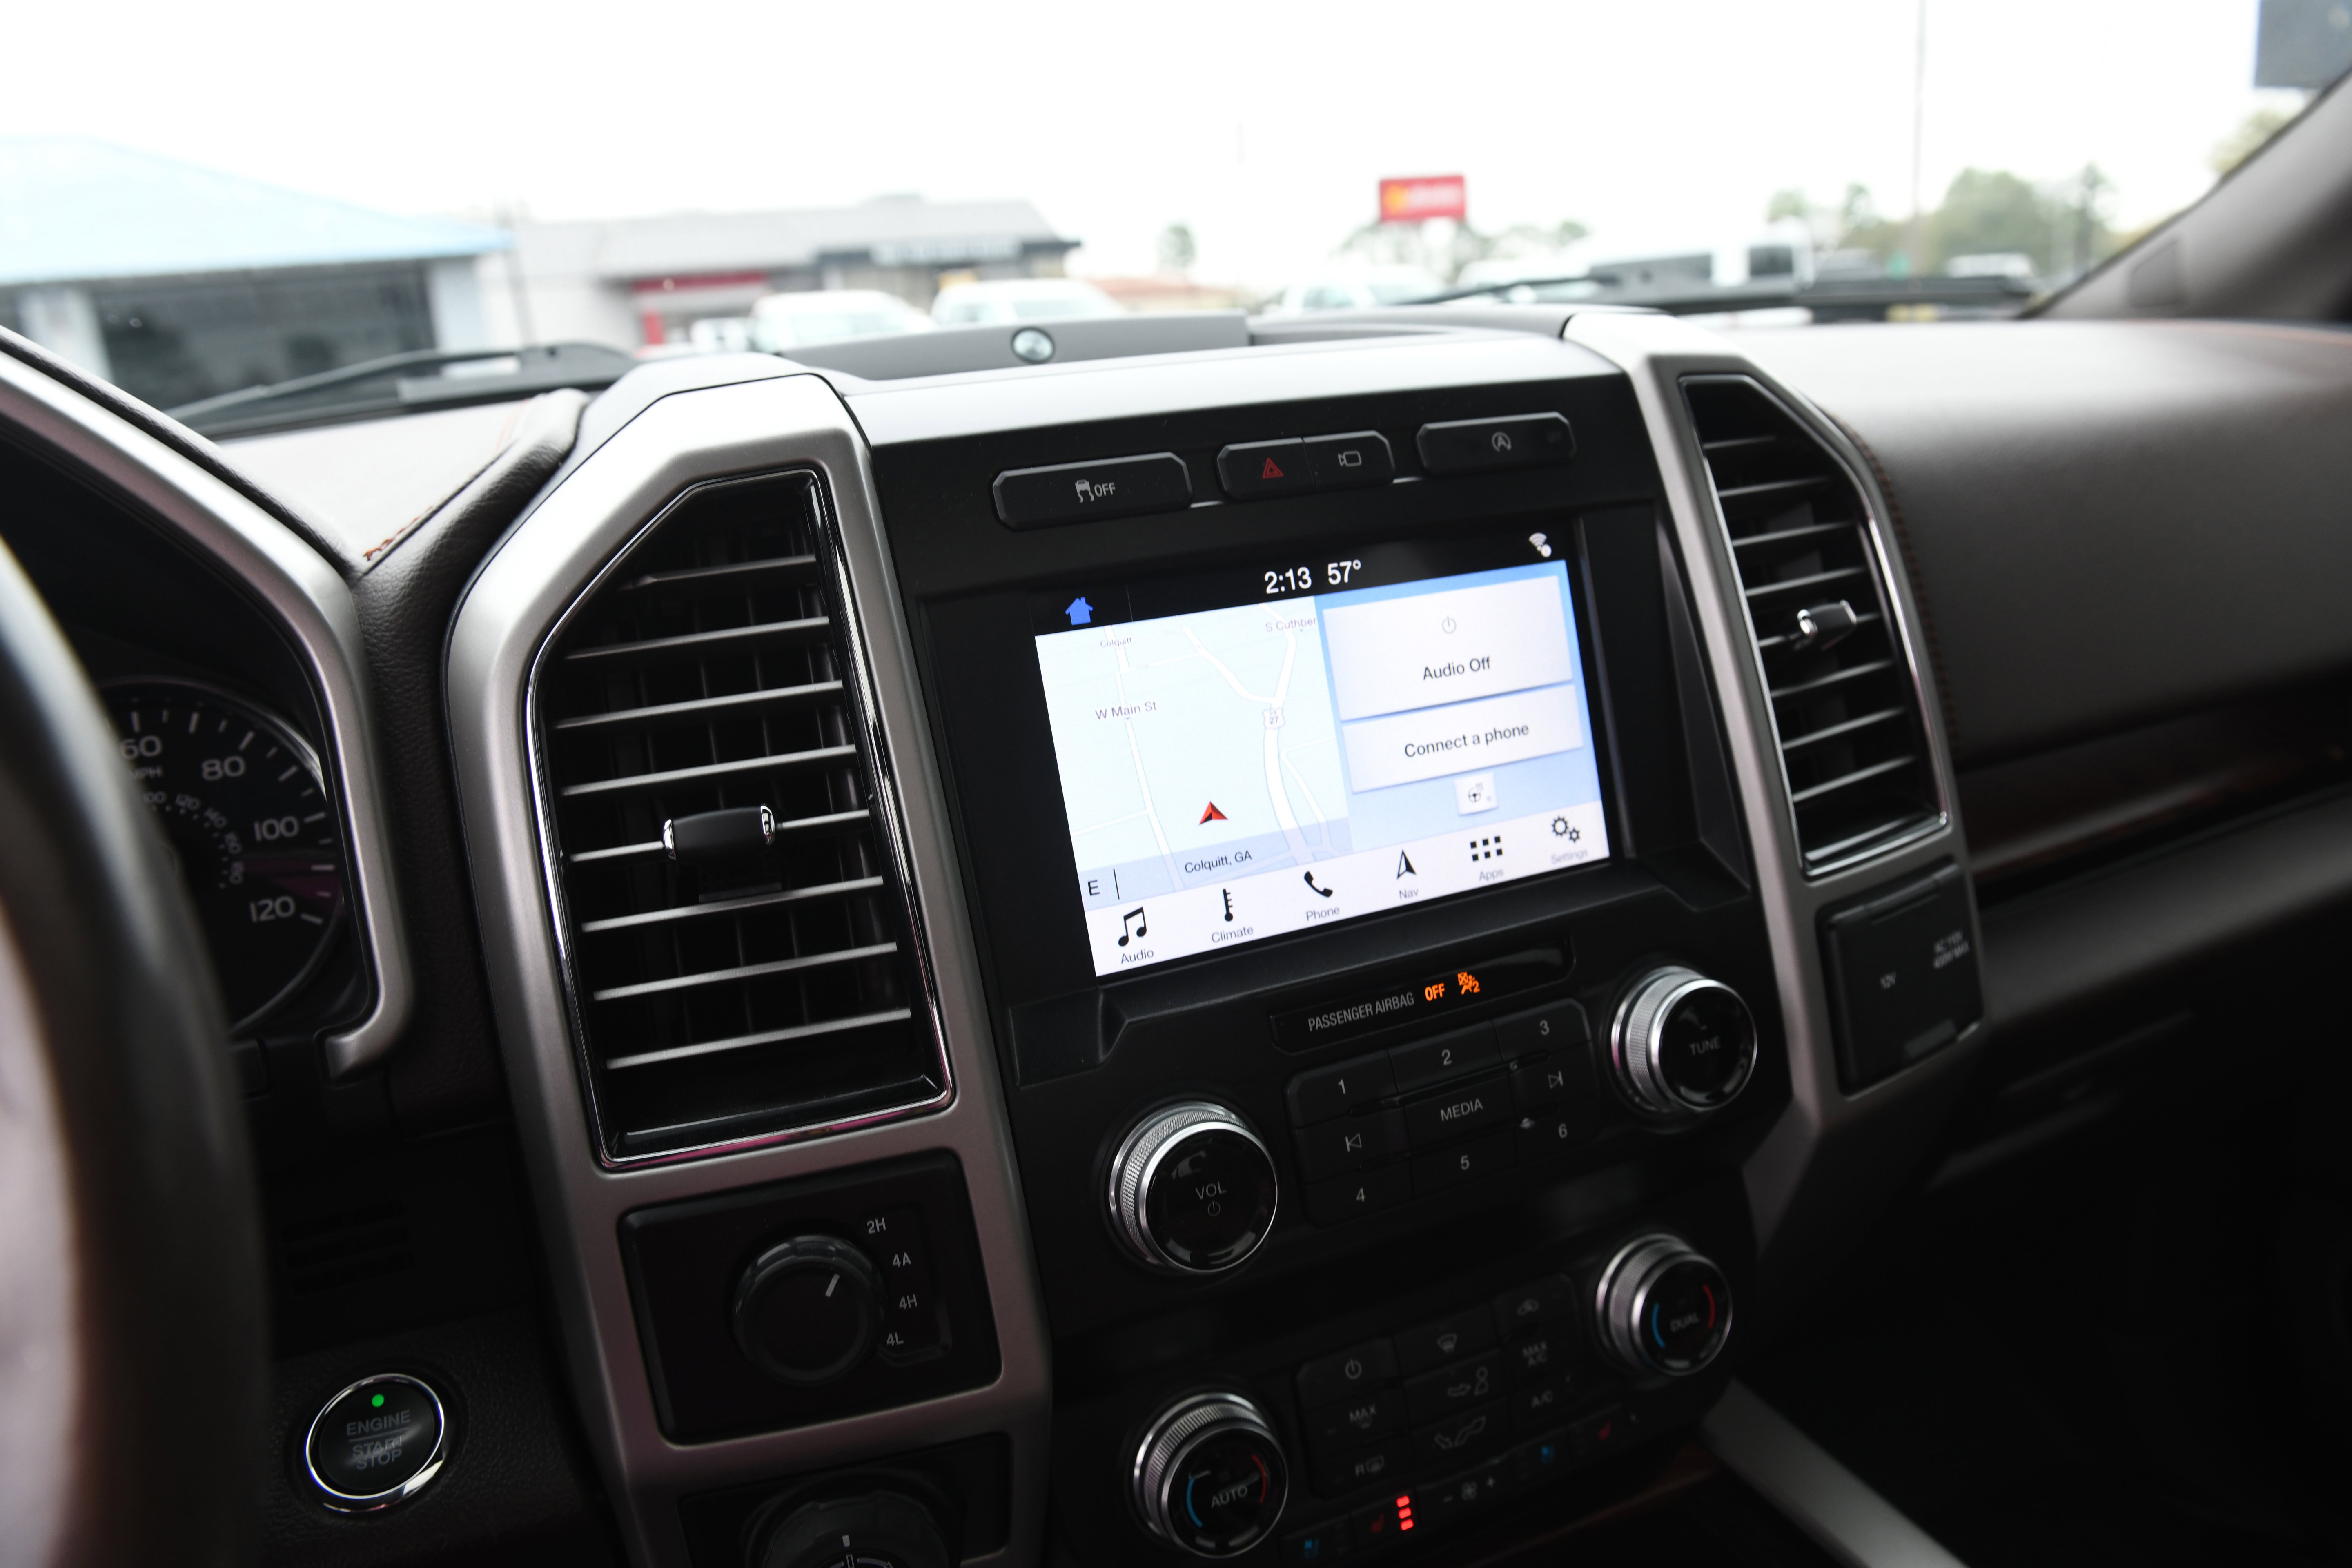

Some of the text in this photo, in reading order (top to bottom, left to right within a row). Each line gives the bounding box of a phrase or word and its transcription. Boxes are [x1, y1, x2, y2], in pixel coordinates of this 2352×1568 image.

[1094, 482, 1116, 497] OFF
[1265, 567, 1312, 594] 2:13
[1266, 622, 1273, 632] S
[1100, 637, 1133, 648] Colquitt
[1423, 657, 1490, 680] Audio Off
[1095, 701, 1157, 720] W Main St
[1269, 716, 1278, 725] 27
[1405, 724, 1529, 758] Connect a phone
[201, 755, 246, 781] 80
[254, 816, 300, 842] 100
[1234, 850, 1253, 863] GA
[1551, 847, 1588, 865] Settings
[1479, 867, 1504, 883] Apps
[1087, 880, 1100, 896] E
[1399, 887, 1419, 900] Nav
[249, 896, 296, 923] 120
[1306, 905, 1340, 922] Phone
[1211, 926, 1254, 944] Climate
[1120, 949, 1154, 964] Audio
[1308, 1002, 1374, 1032] PASSENGER
[1375, 991, 1415, 1015] AIRBAG
[1424, 982, 1446, 1002] OFF
[1539, 1019, 1550, 1036] 3
[1689, 1035, 1721, 1056] TUNE
[1441, 1049, 1452, 1065] 2
[1337, 1079, 1348, 1094] 1
[1440, 1098, 1483, 1122] MEDIA
[1558, 1123, 1568, 1138] 6
[1460, 1155, 1470, 1170] 5
[1196, 1181, 1226, 1200] VOL
[1356, 1187, 1366, 1203] 4
[866, 1218, 886, 1234] 2H
[892, 1252, 912, 1267] 4A
[899, 1294, 918, 1309] 4H
[886, 1332, 904, 1346] 4L
[1349, 1403, 1377, 1423] MAX
[346, 1410, 411, 1437] ENGINE
[352, 1435, 403, 1458] START
[356, 1448, 402, 1470] STOP
[1210, 1484, 1248, 1509] AUTO
